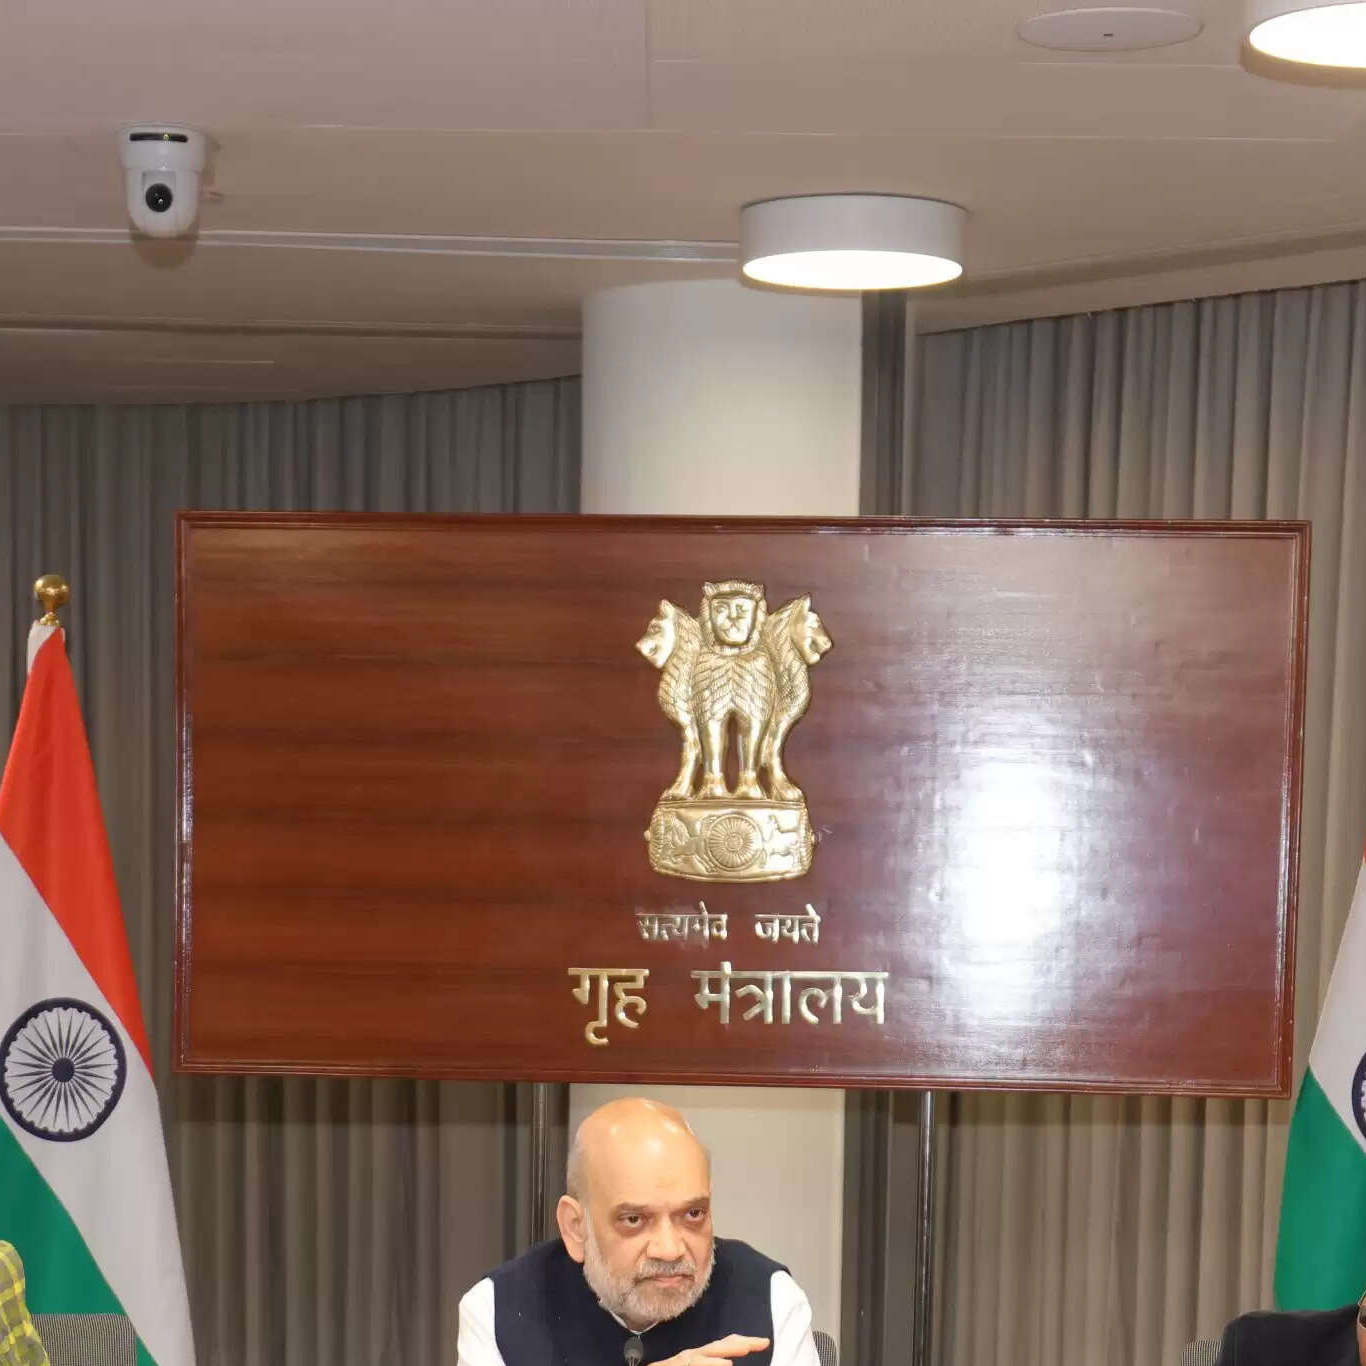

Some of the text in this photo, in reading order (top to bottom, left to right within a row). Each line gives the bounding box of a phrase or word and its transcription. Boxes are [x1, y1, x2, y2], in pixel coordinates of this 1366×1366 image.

[635, 900, 821, 944] सत्यमेव जयते
[567, 961, 890, 1046] गृह मंत्रालय
